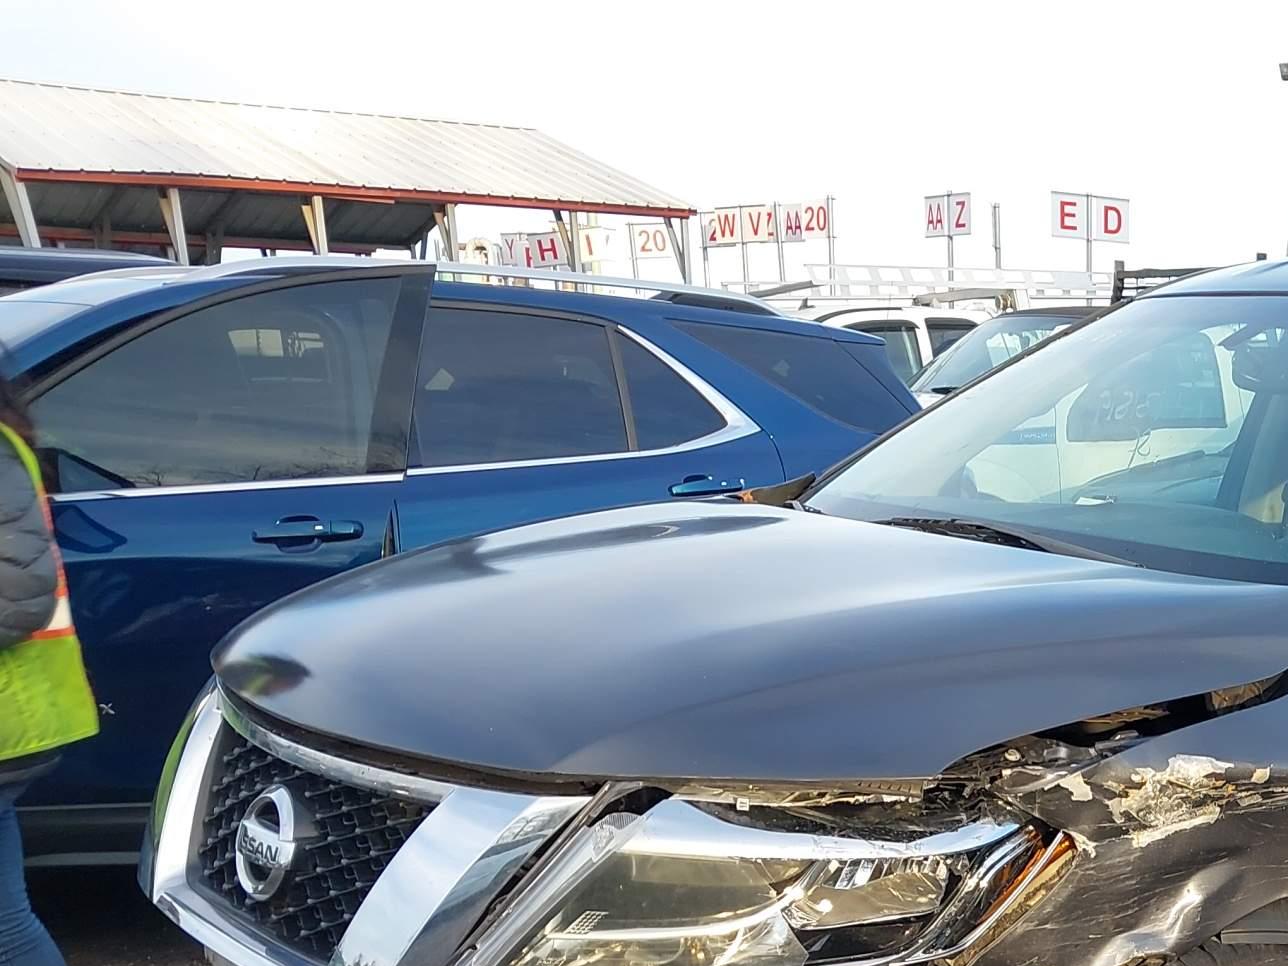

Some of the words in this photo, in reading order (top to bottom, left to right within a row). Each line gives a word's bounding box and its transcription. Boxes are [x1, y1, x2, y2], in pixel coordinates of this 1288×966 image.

[717, 213, 735, 238] W
[748, 212, 761, 236] V
[785, 210, 802, 237] AA
[804, 206, 827, 232] 20
[927, 202, 943, 231] AA
[955, 201, 966, 228] Z
[1060, 201, 1077, 230] E
[1104, 205, 1122, 235] D
[536, 238, 559, 262] H
[638, 229, 666, 252] 20
